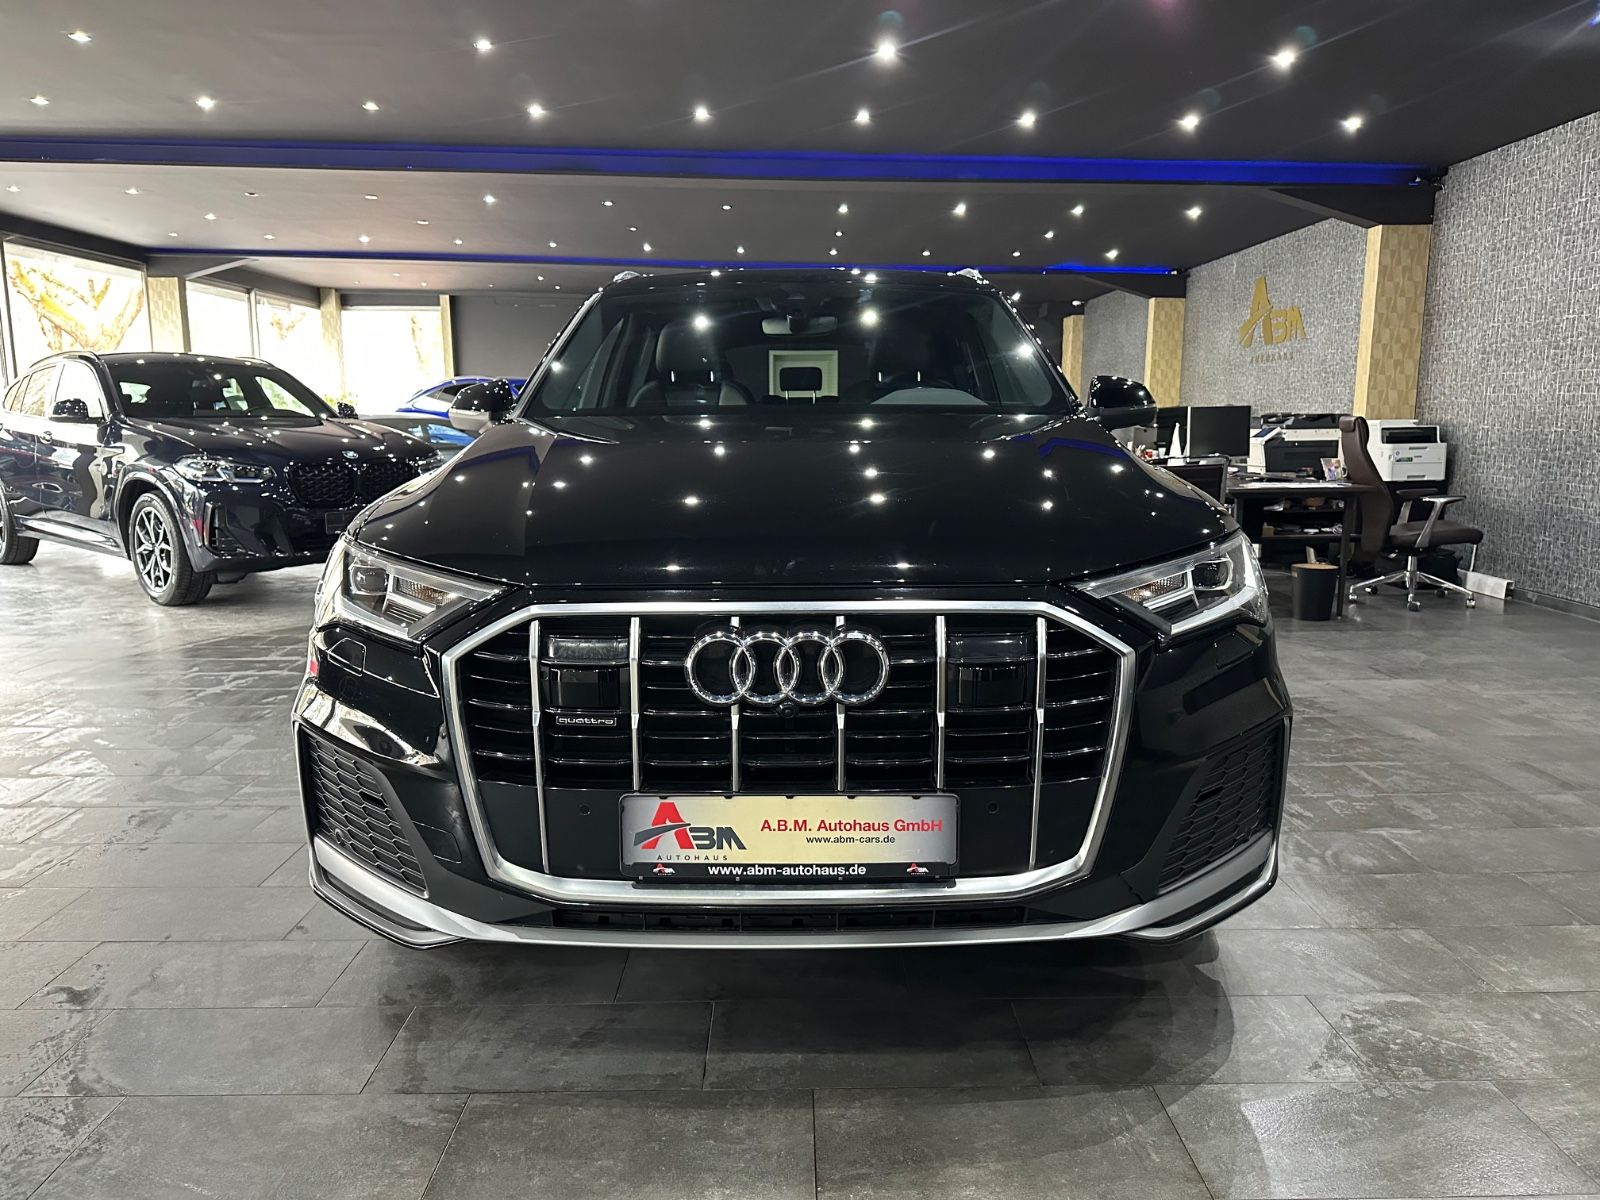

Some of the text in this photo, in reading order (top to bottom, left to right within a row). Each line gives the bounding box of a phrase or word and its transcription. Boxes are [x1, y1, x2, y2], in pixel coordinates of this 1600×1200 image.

[558, 717, 614, 725] quattro
[760, 819, 943, 832] A.B.M. Autohaus GmbH
[806, 834, 896, 844] www.abm-cars.de
[707, 864, 867, 876] www.abm-autohaus.de
